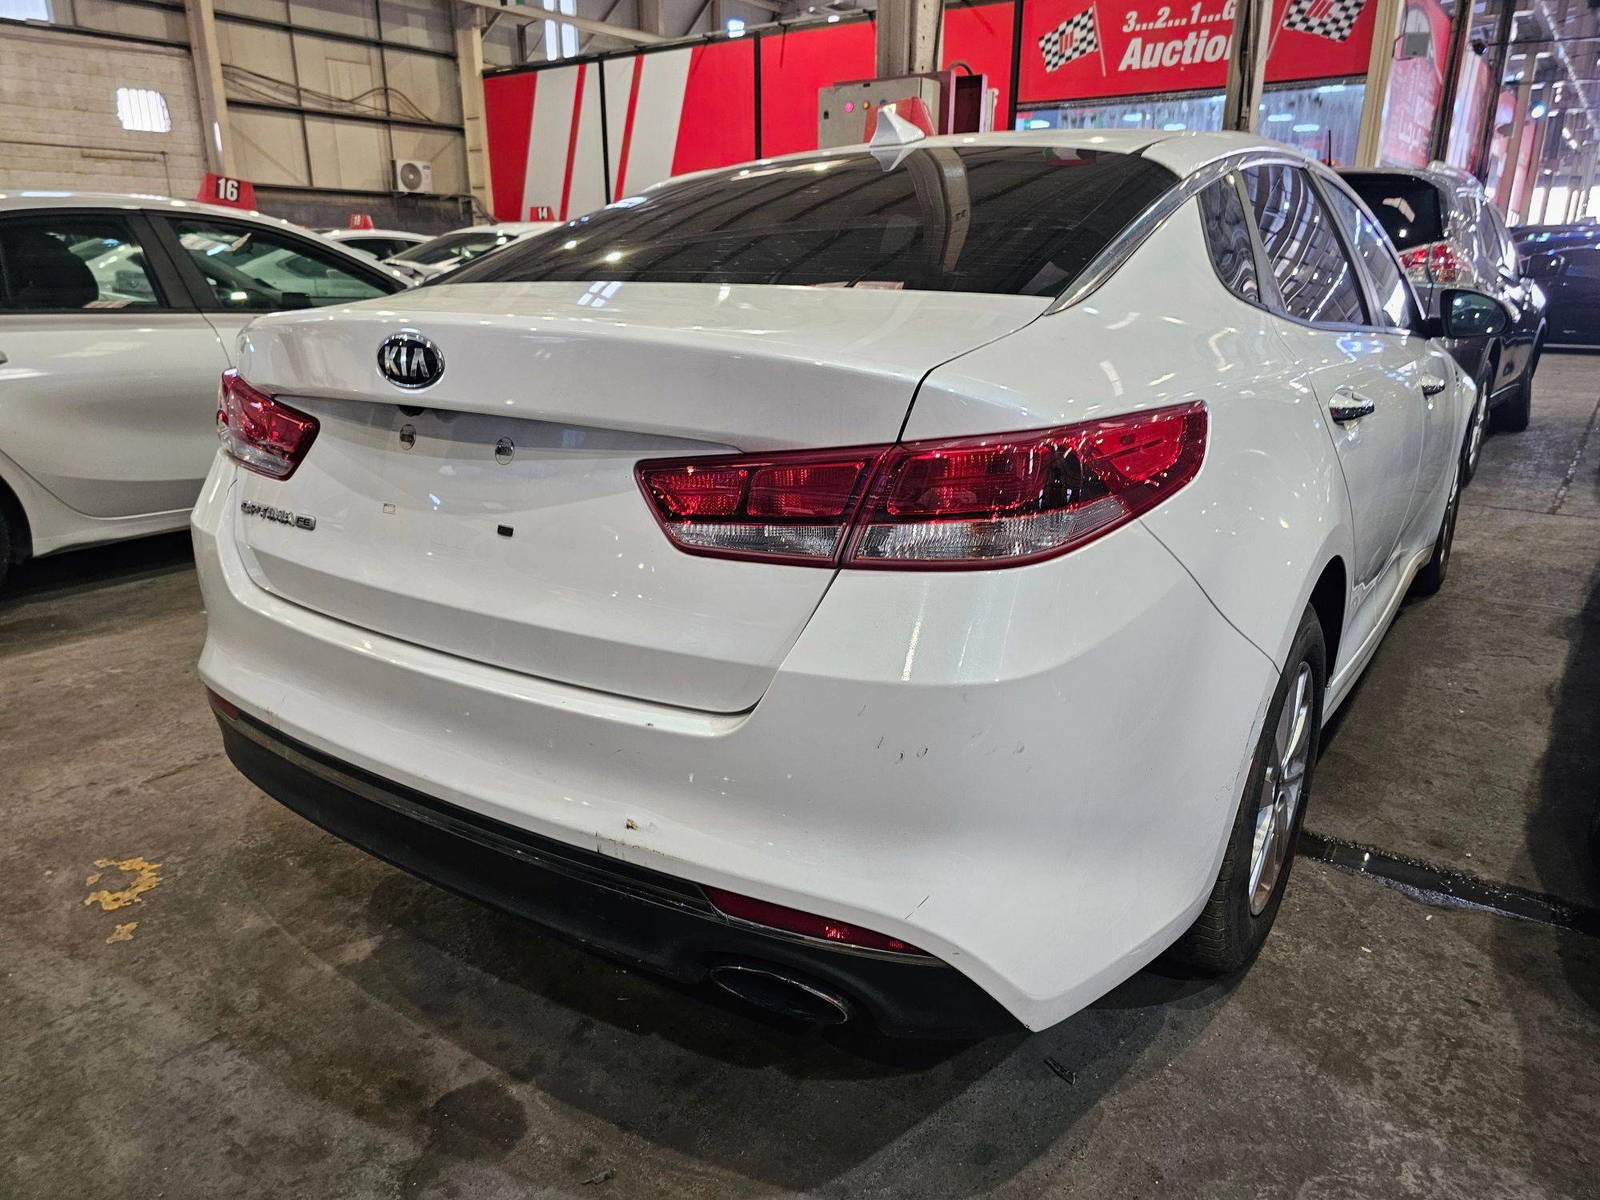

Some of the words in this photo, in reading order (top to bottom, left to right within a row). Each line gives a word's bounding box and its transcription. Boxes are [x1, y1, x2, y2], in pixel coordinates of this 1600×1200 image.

[218, 177, 239, 201] 16
[538, 207, 548, 219] 14
[384, 346, 430, 378] KIA
